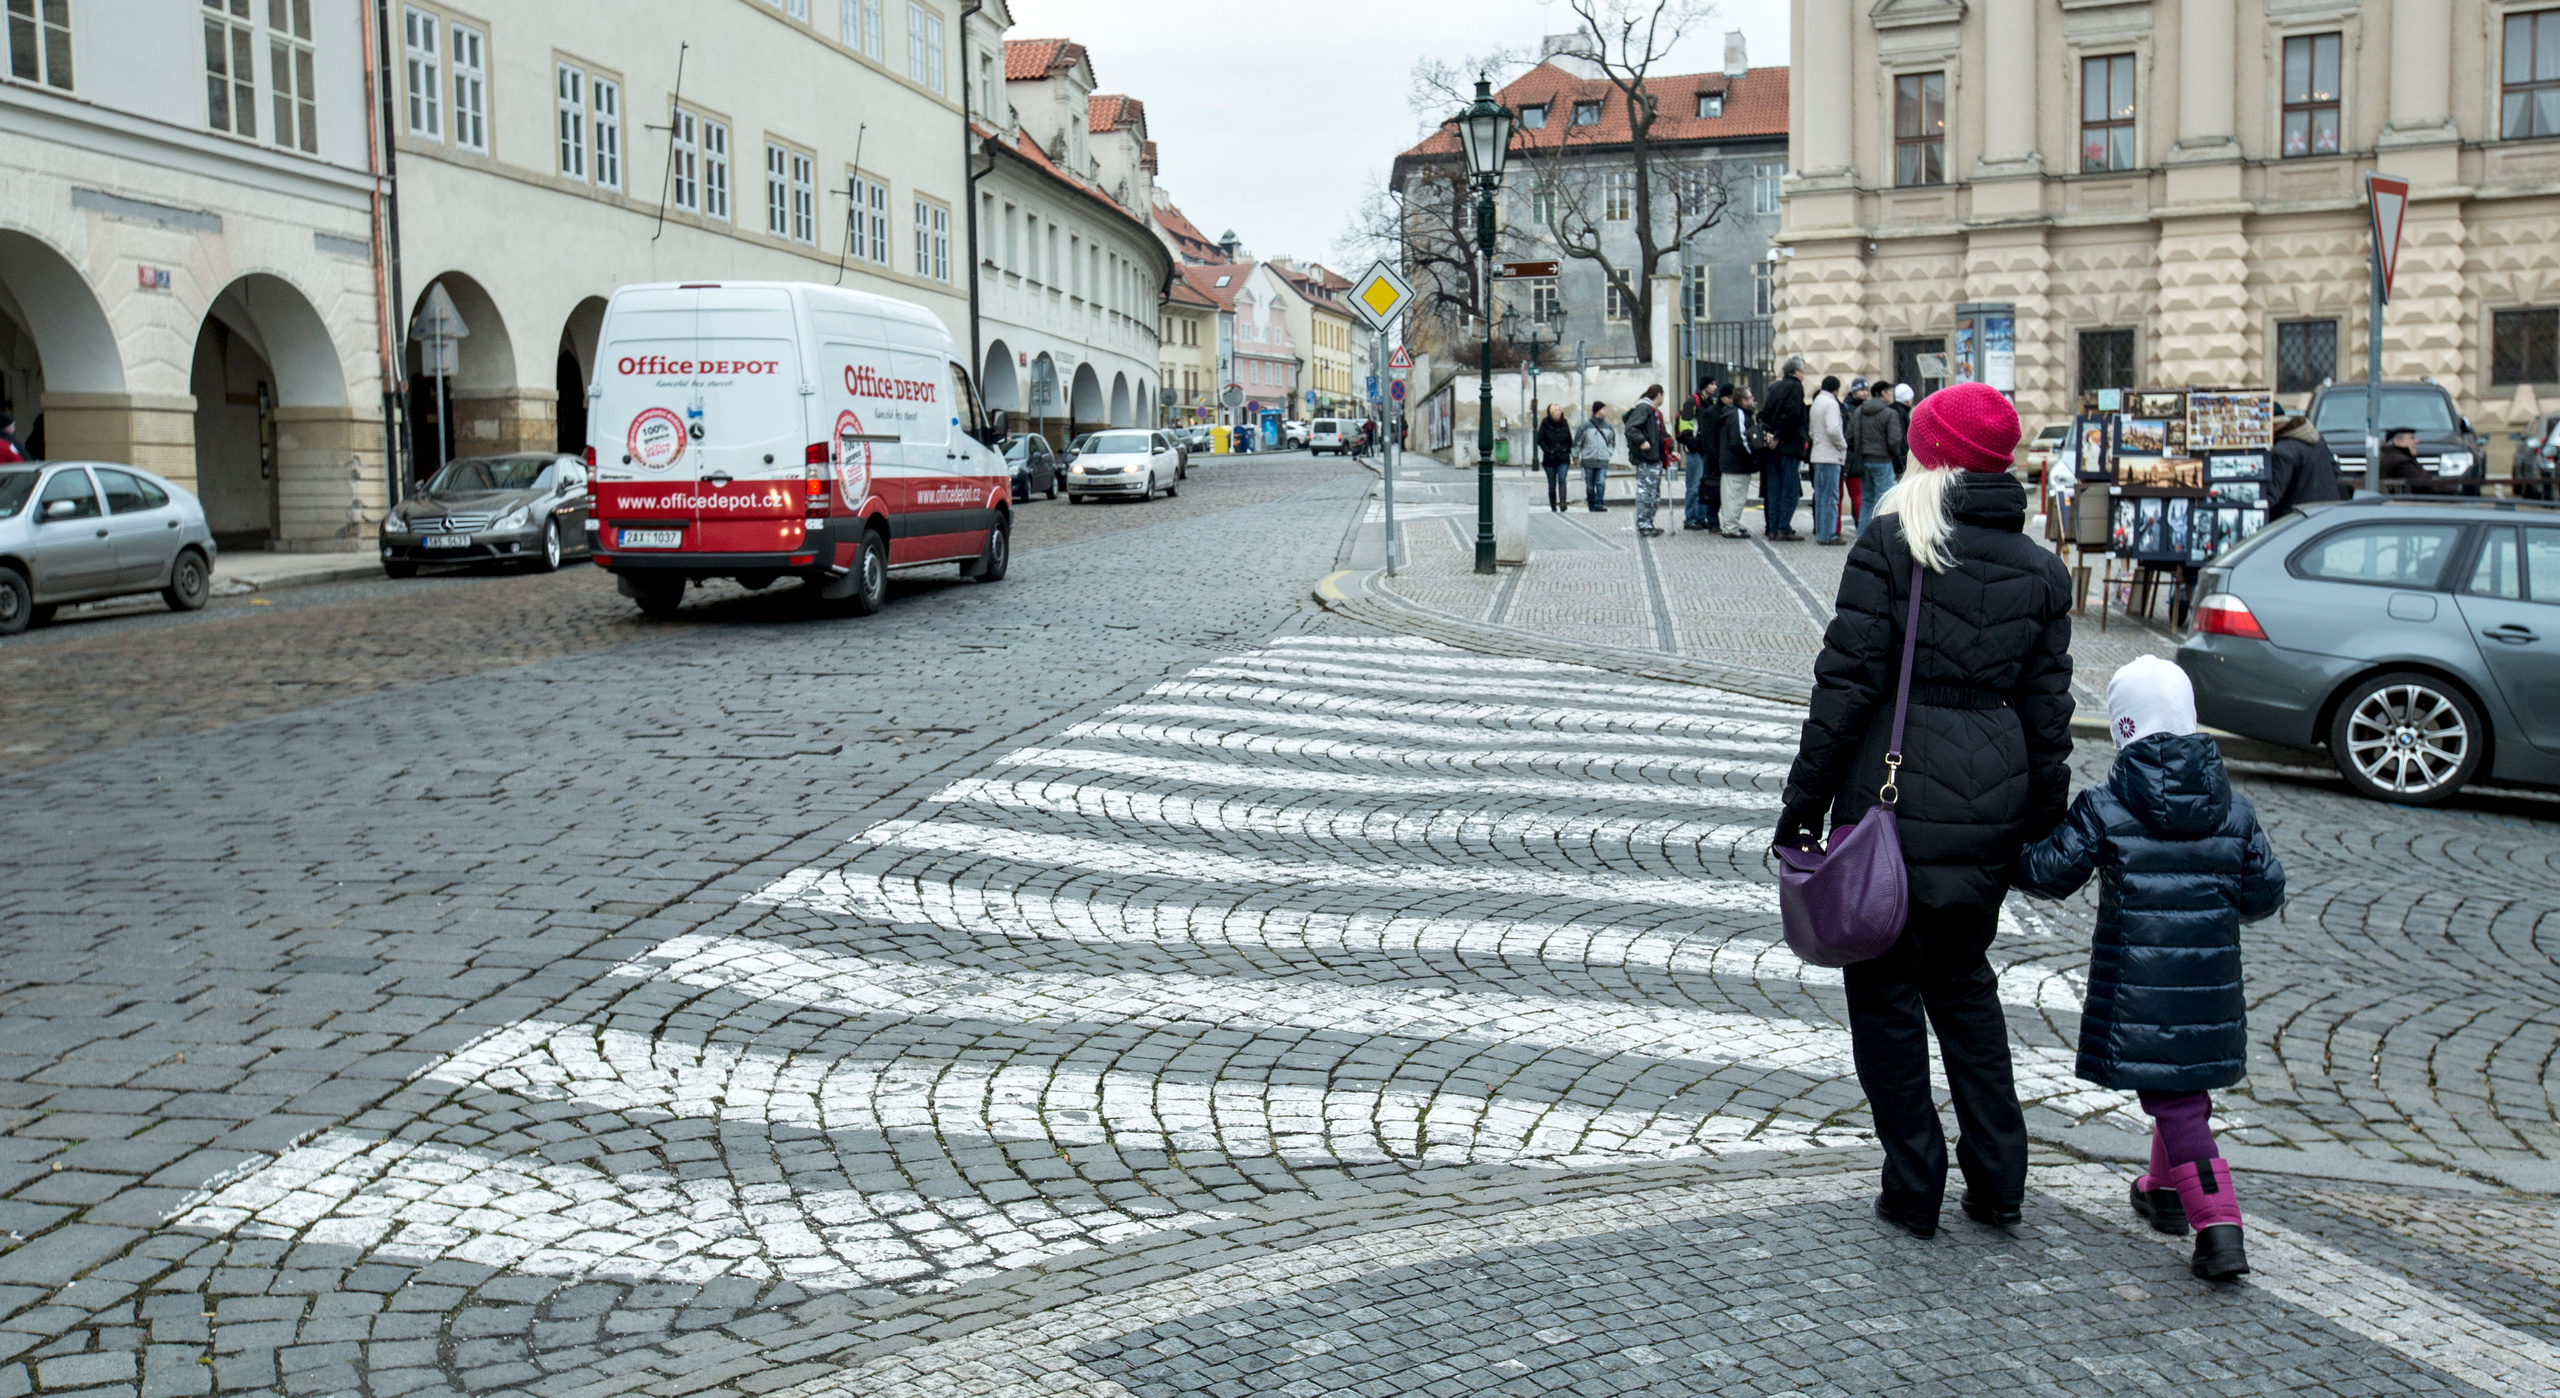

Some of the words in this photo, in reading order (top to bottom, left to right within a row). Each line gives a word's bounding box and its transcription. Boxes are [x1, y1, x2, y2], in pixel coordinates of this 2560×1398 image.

[618, 356, 693, 375] Office
[698, 361, 779, 374] DEPOT
[844, 364, 893, 399] Office
[894, 379, 936, 403] DEPOT
[643, 423, 669, 436] 100%
[617, 493, 783, 511] www.officedepot.cz
[917, 484, 981, 507] www.officedepot.cz
[626, 532, 644, 543] 2AX
[653, 532, 677, 543] 1037
